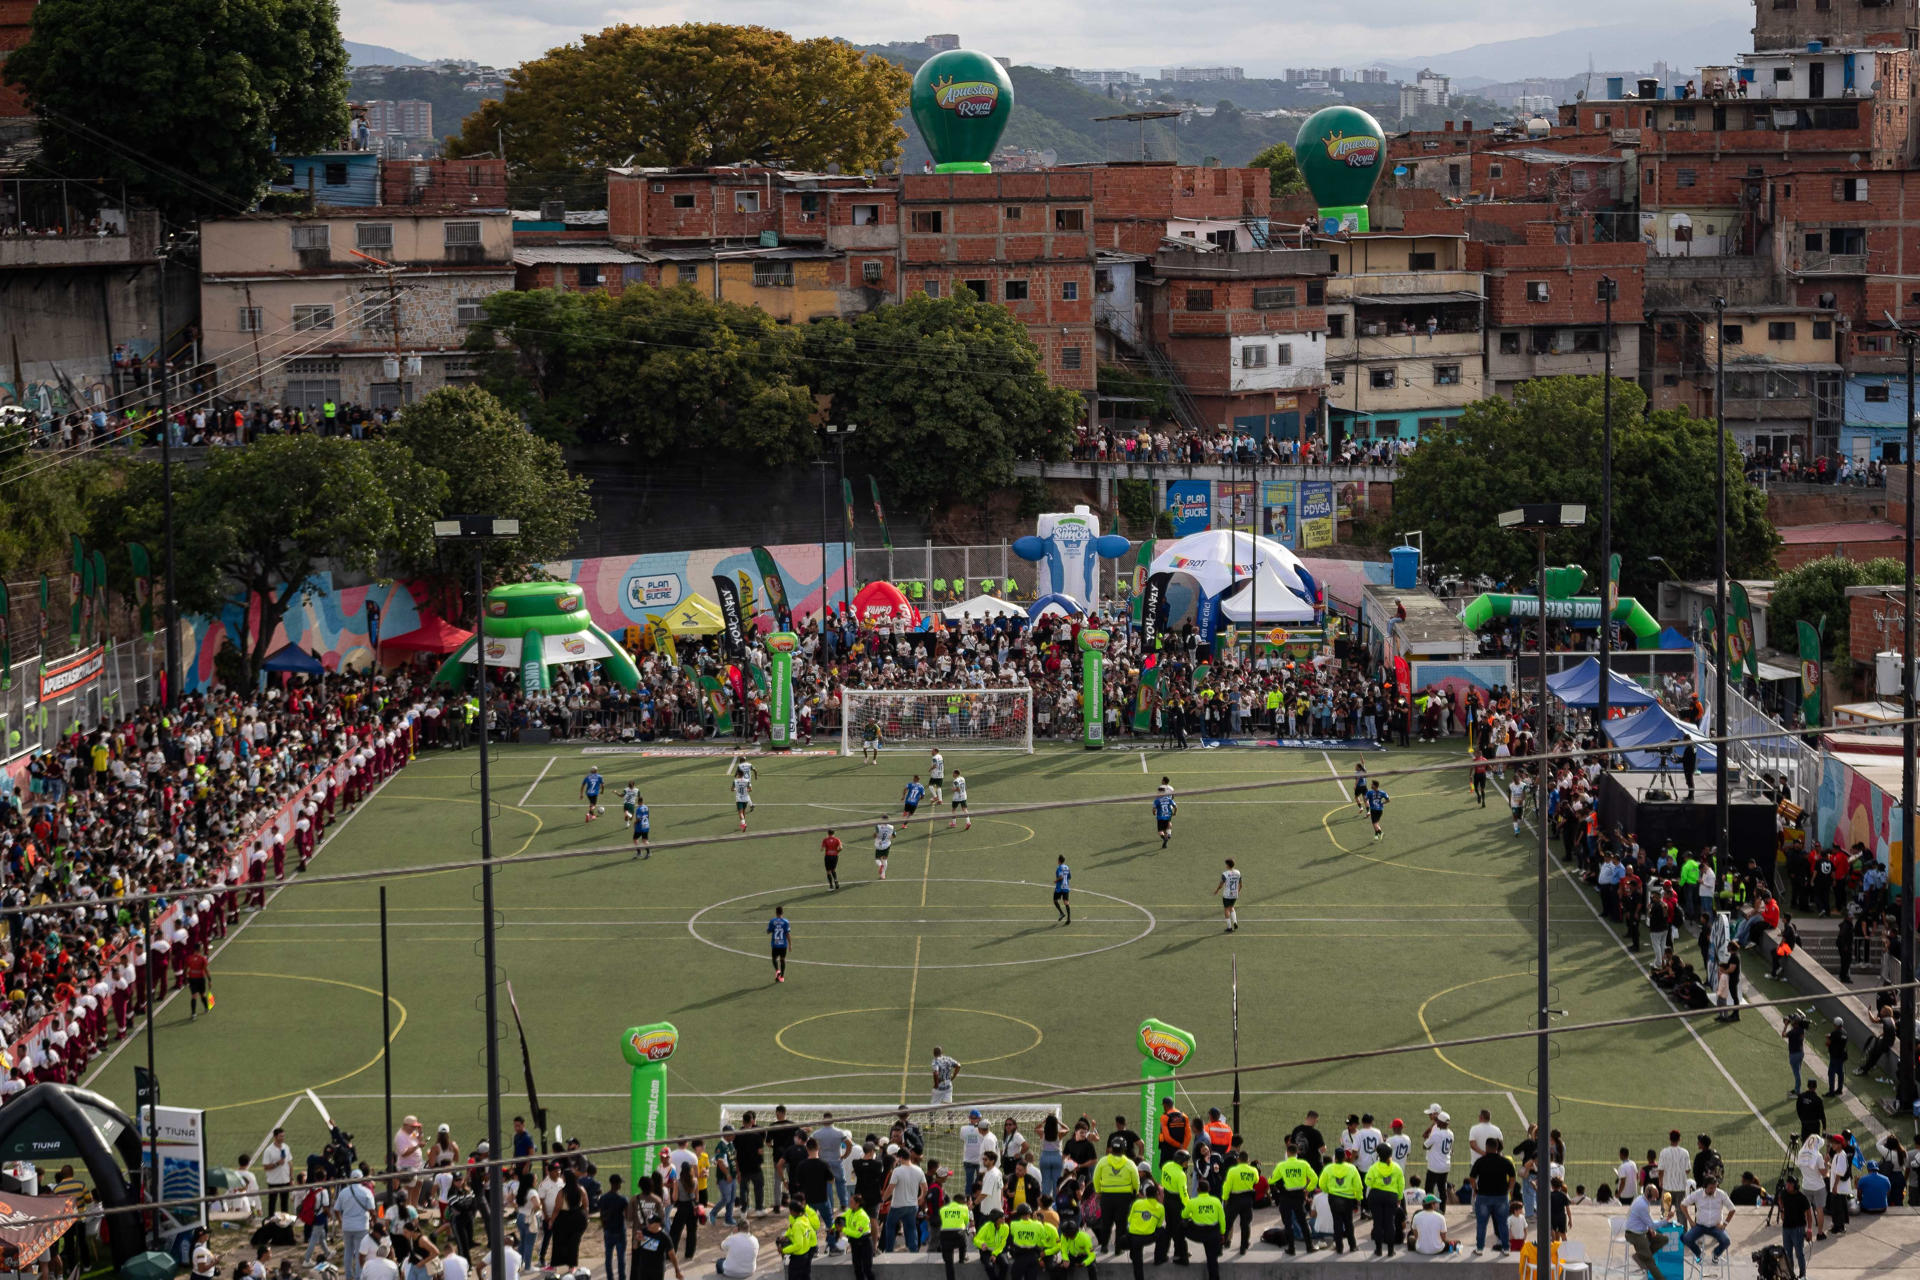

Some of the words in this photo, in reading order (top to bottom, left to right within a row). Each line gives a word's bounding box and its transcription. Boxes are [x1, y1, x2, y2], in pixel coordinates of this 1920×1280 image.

[941, 82, 995, 106] Apuestas
[958, 99, 993, 117] Royal
[1333, 138, 1377, 157] Apuestas
[1348, 151, 1376, 167] Royal
[1186, 494, 1206, 504] PLAN
[1184, 507, 1208, 518] SUCRE
[1303, 502, 1331, 516] PDVSA
[1187, 559, 1207, 568] BDT
[647, 580, 669, 589] PLAN
[646, 591, 672, 600] SUCRE
[1510, 599, 1573, 618] APUSTAS
[638, 1033, 676, 1049] Apuestas
[1149, 1034, 1185, 1053] Apuestas
[650, 1045, 672, 1059] Royal
[1157, 1046, 1181, 1062] Royal
[165, 1126, 196, 1137] TIUNA
[32, 1140, 61, 1150] TIUNA
